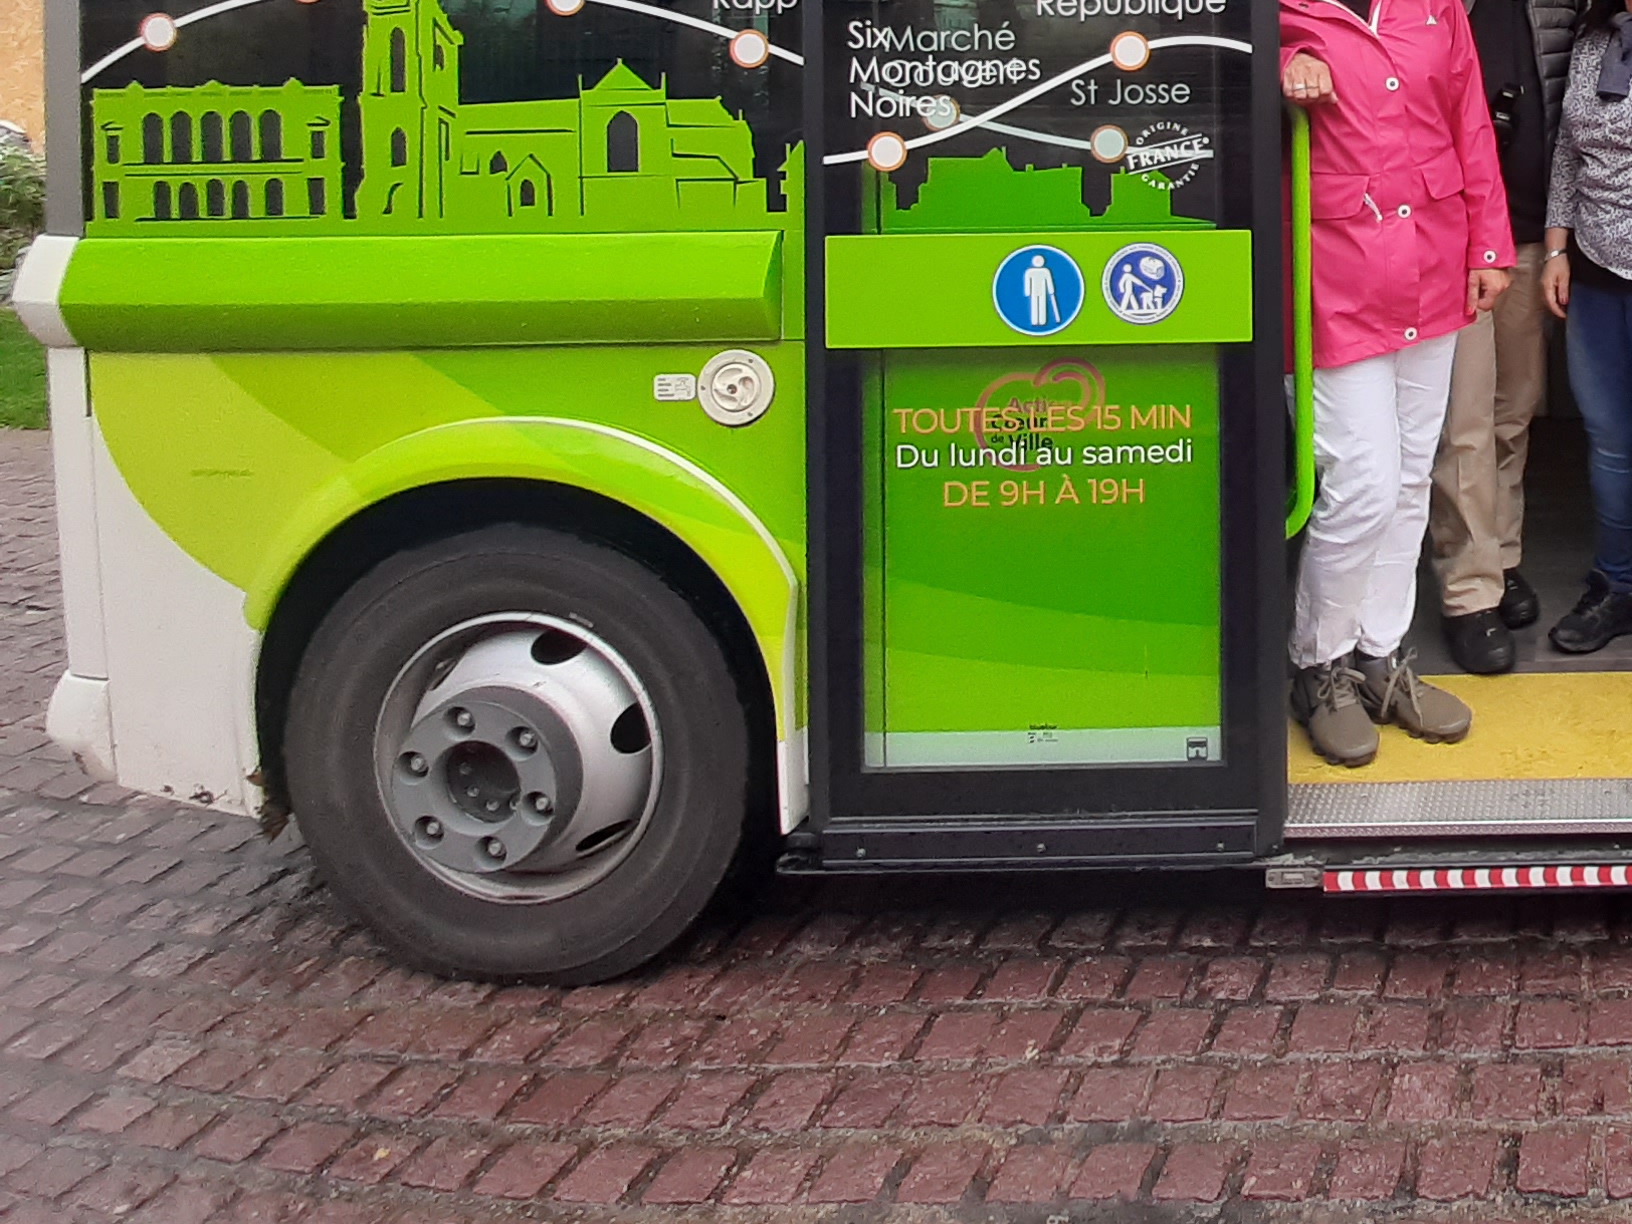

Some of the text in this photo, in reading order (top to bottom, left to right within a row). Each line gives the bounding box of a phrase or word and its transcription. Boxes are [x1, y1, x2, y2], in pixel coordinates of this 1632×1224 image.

[847, 20, 889, 49] Six
[885, 21, 1016, 52] Marché
[850, 54, 1041, 88] Montagnes
[850, 89, 952, 118] Noires
[1071, 79, 1191, 106] St Josse
[1135, 121, 1189, 146] ORIGINE
[1126, 138, 1203, 170] FRANCE
[1141, 163, 1200, 190] GARANTIE
[893, 404, 1193, 435] TOUTES LES 15 MIN
[896, 438, 1193, 468] Du lundi au samedi
[943, 473, 1147, 508] DE 9H À 19H
